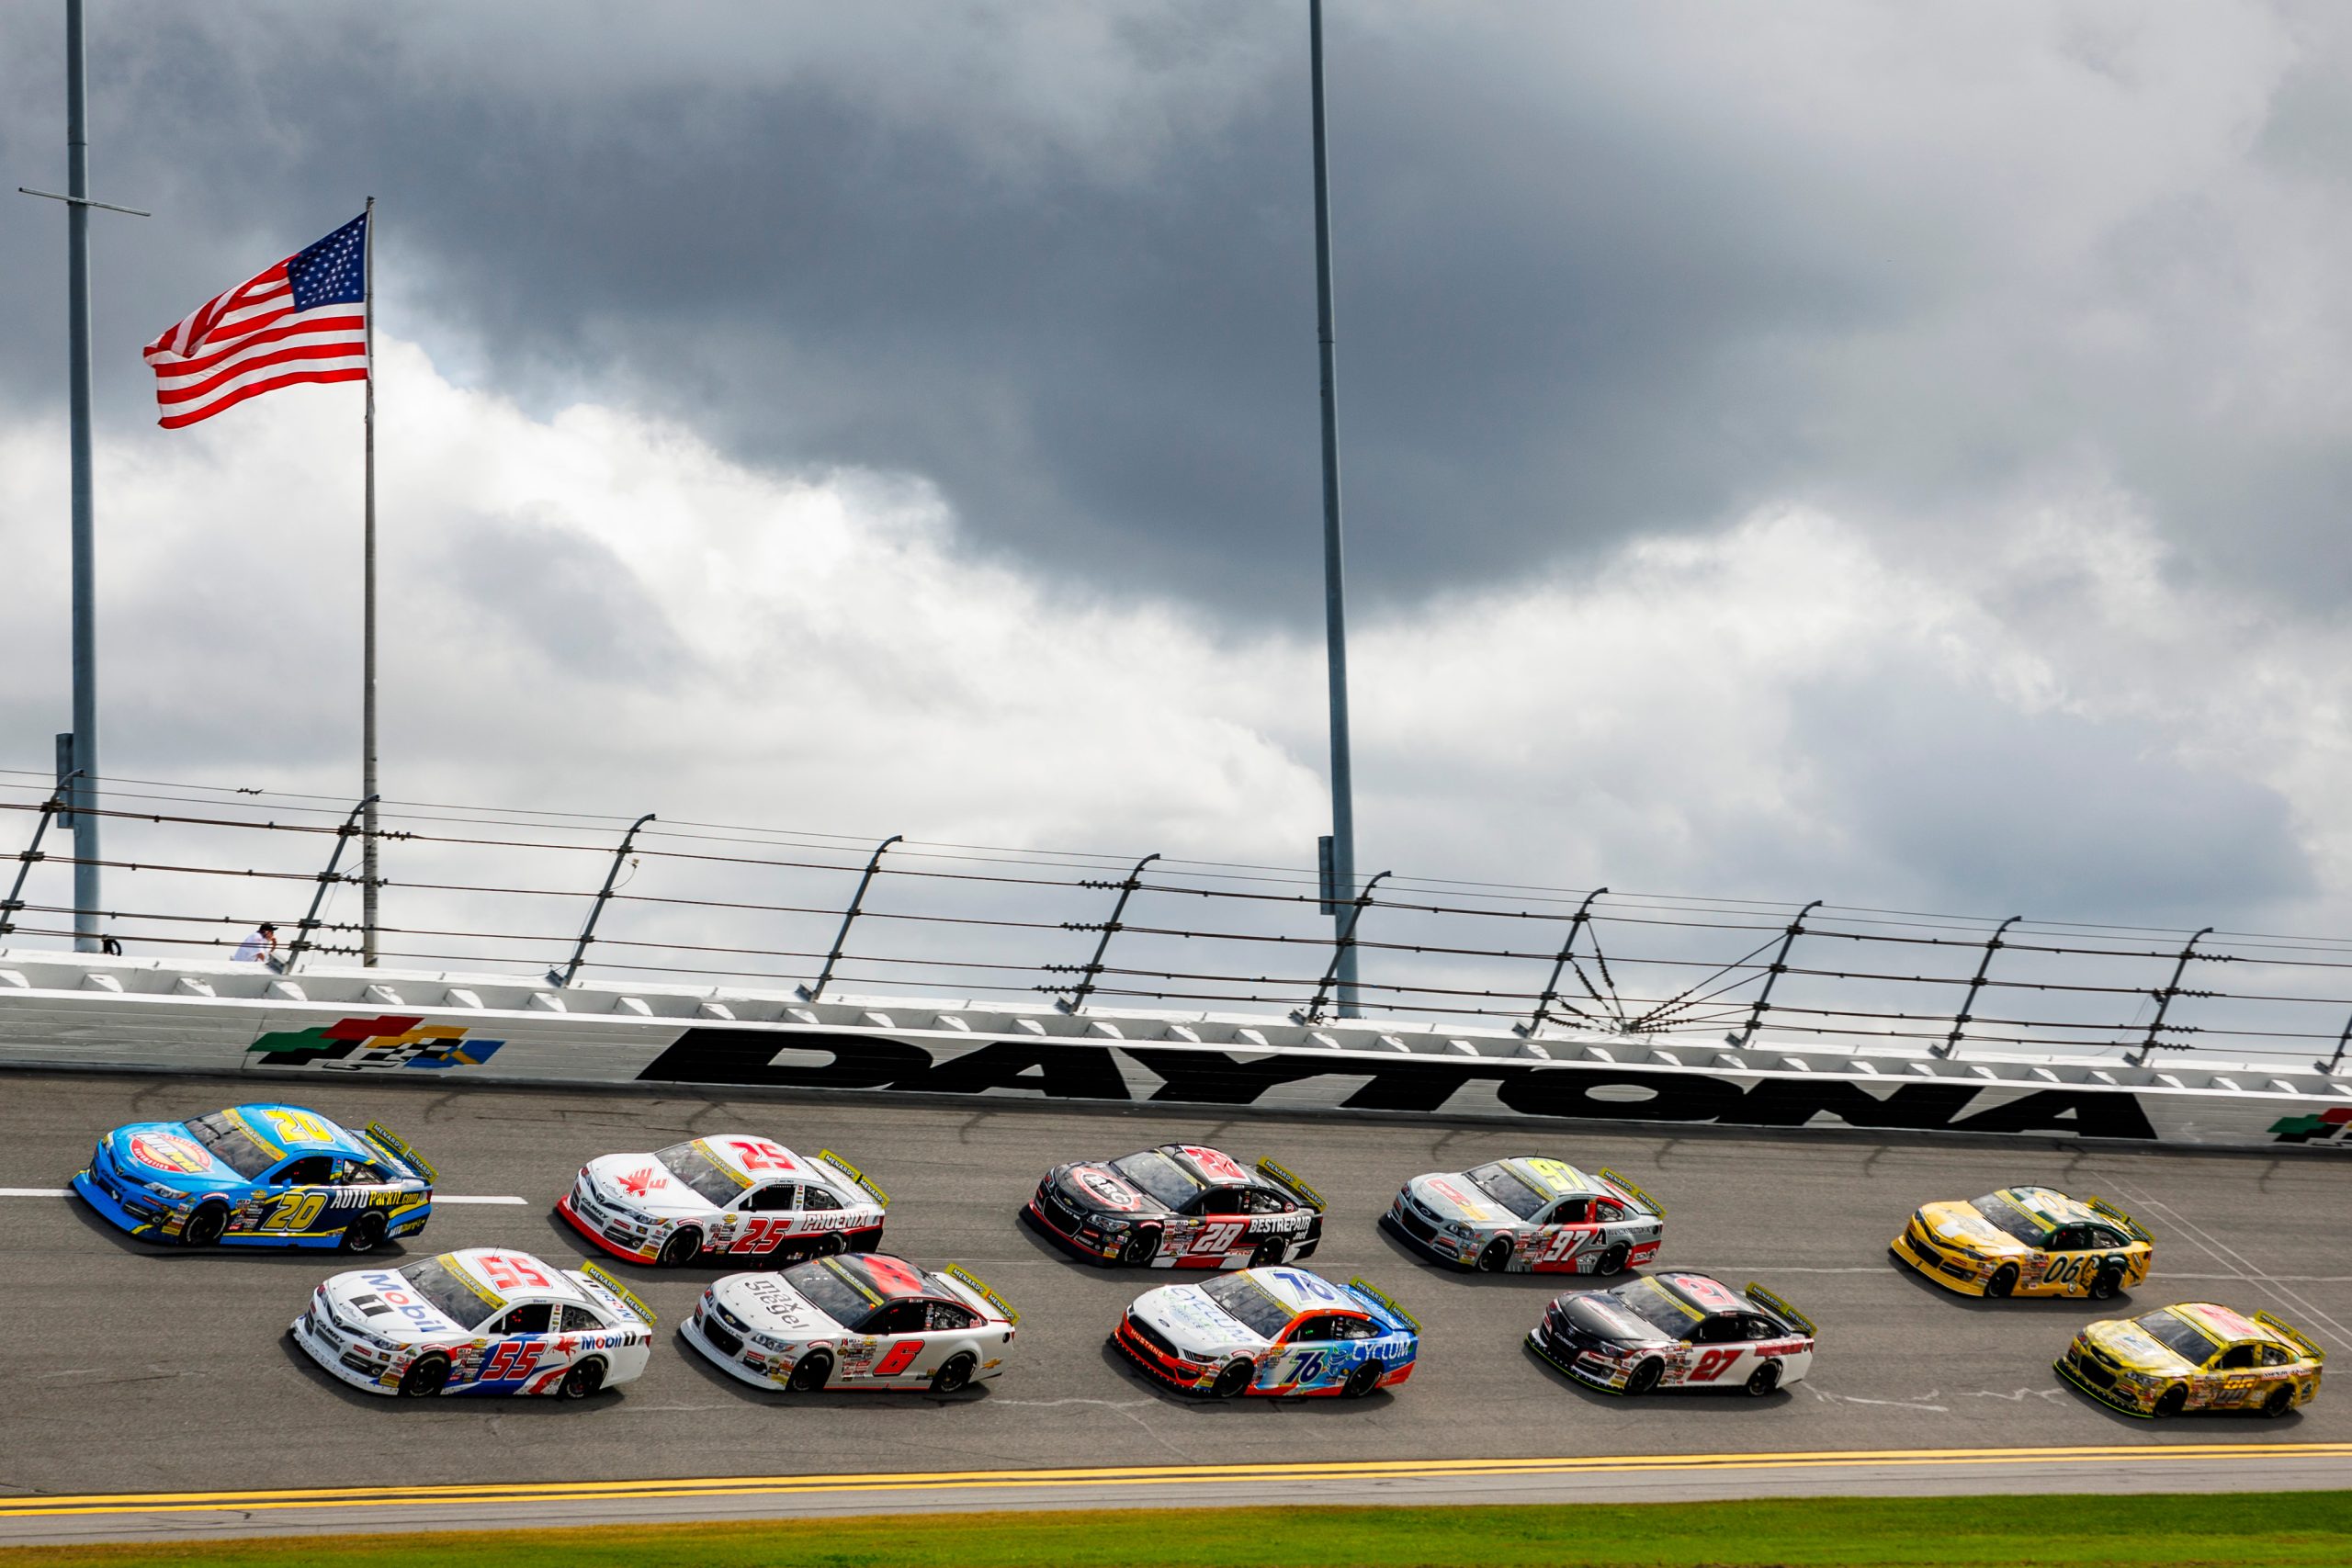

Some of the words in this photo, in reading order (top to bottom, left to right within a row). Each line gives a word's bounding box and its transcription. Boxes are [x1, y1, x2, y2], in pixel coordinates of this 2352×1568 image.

[634, 1027, 2158, 1140] DAYTONA
[264, 1110, 334, 1144] 20
[372, 1123, 404, 1151] MENARDS
[407, 1151, 435, 1177] MENARDS
[727, 1141, 798, 1171] 25
[825, 1155, 857, 1179] MENARDS
[1264, 1160, 1295, 1182] MENARDS
[1527, 1159, 1589, 1191] 97
[1604, 1171, 1633, 1191] MENARDS
[859, 1179, 886, 1204] MENARDS
[1299, 1185, 1325, 1206] MENARDS
[262, 1193, 327, 1231] 20
[581, 1198, 608, 1219] CAMRY
[801, 1211, 869, 1232] PHOENIX
[729, 1217, 794, 1254] 25
[1191, 1224, 1245, 1252] 28
[1249, 1216, 1312, 1234] BESTREPAIR
[1544, 1231, 1591, 1262] 97
[476, 1256, 551, 1291] 55
[589, 1268, 621, 1294] MENARDS
[953, 1269, 985, 1293] MENARDS
[2043, 1255, 2086, 1284] 06
[755, 1280, 803, 1313] max
[1270, 1270, 1338, 1304] 76
[1356, 1281, 1387, 1307] MENARDS
[1675, 1278, 1739, 1307] 27
[361, 1274, 448, 1332] Mobil
[624, 1296, 653, 1324] MENARDS
[744, 1281, 809, 1329] siegel
[988, 1294, 1015, 1320] MENARDS
[317, 1319, 345, 1343] CAMRY
[582, 1335, 622, 1350] Mobil
[1131, 1329, 1164, 1359] MUSTANG
[480, 1340, 548, 1381] 55
[873, 1339, 926, 1376] 6
[1352, 1340, 1411, 1361] CYCLUM
[1283, 1350, 1325, 1384] 76
[1687, 1348, 1746, 1382] 27
